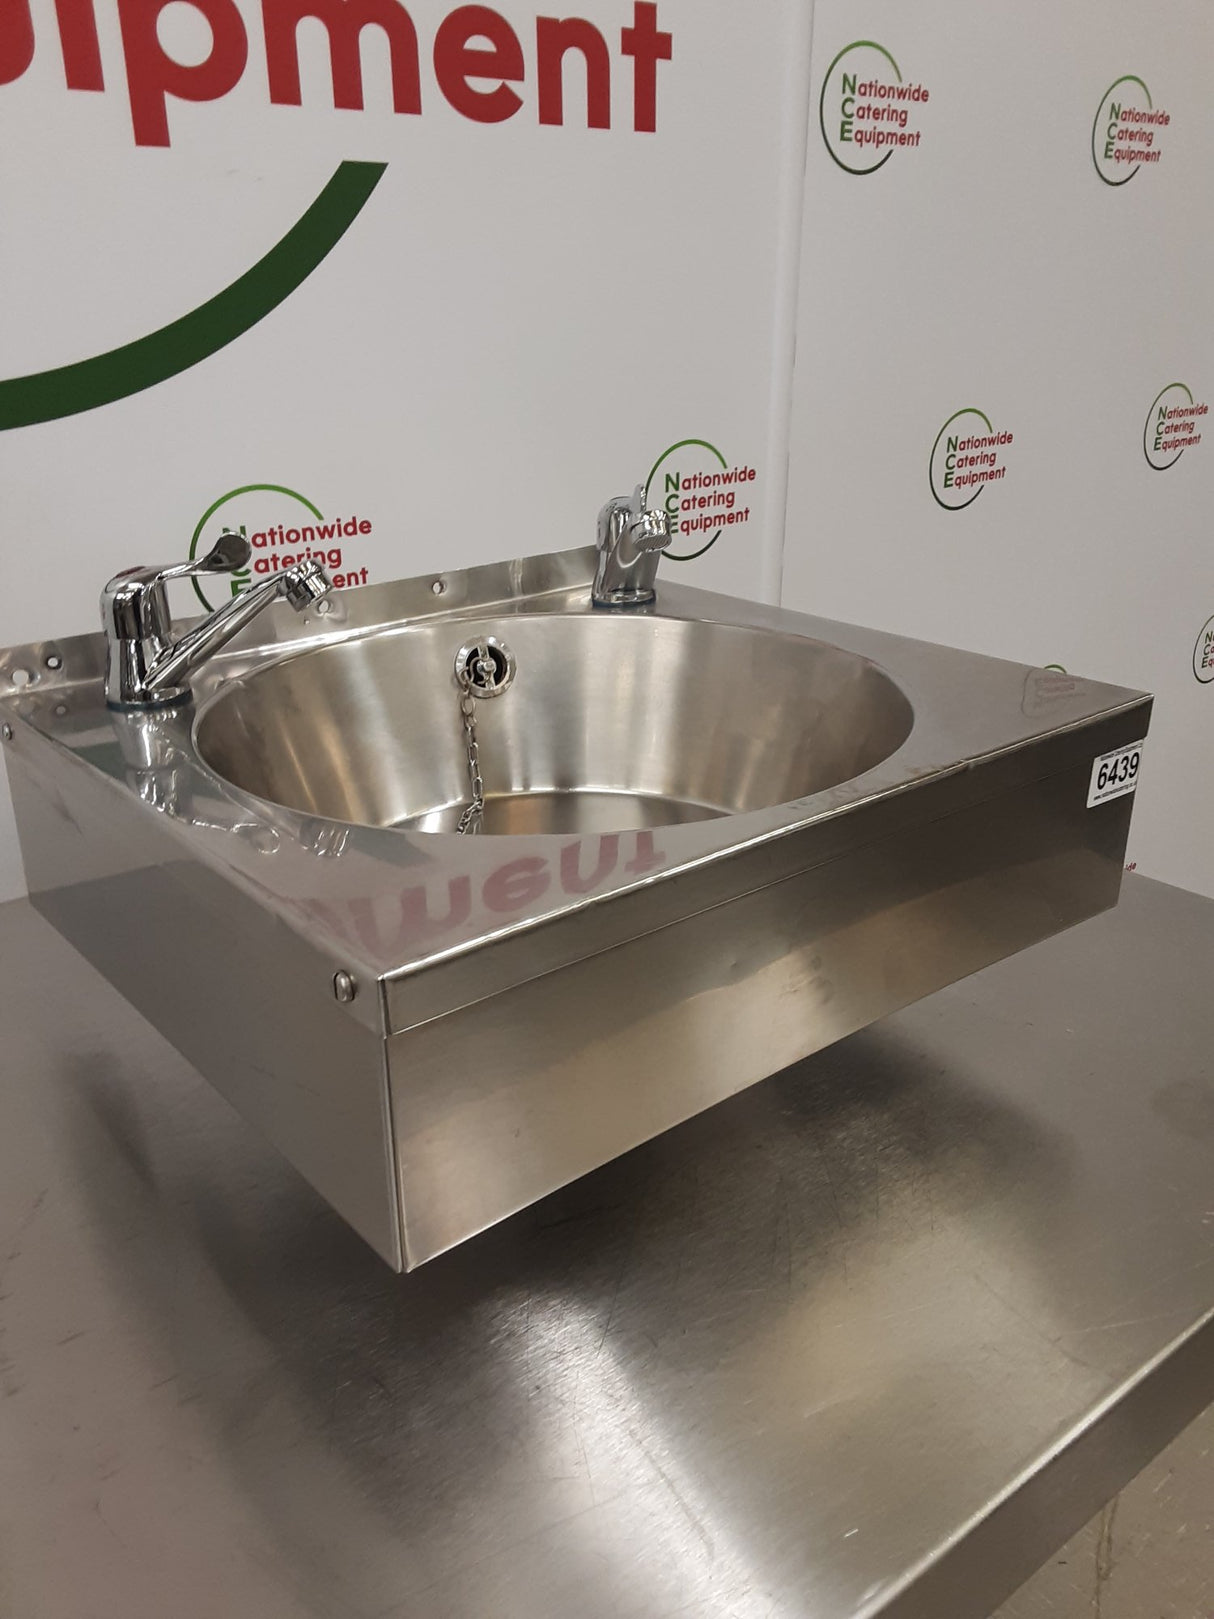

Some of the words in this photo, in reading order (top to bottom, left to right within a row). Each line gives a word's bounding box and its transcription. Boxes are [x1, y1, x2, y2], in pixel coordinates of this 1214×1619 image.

[0, 0, 672, 147] ipment
[842, 72, 929, 102] Nationwide
[841, 97, 908, 127] Catering
[1109, 102, 1170, 125] Nationwide
[840, 120, 921, 149] Equipment
[1107, 122, 1154, 147] Catering
[1104, 141, 1161, 164] Equipment
[1158, 403, 1208, 421] Nationwide
[1156, 420, 1195, 436] Catering
[946, 430, 1014, 453] Nationwide
[1153, 433, 1202, 452] Equipment
[945, 451, 997, 470] Catering
[665, 465, 756, 493] Nationwide
[943, 466, 1006, 490] Equipment
[665, 490, 735, 513] Catering
[222, 516, 372, 549] ationwide
[231, 547, 342, 577] atering
[1097, 751, 1140, 790] 6439
